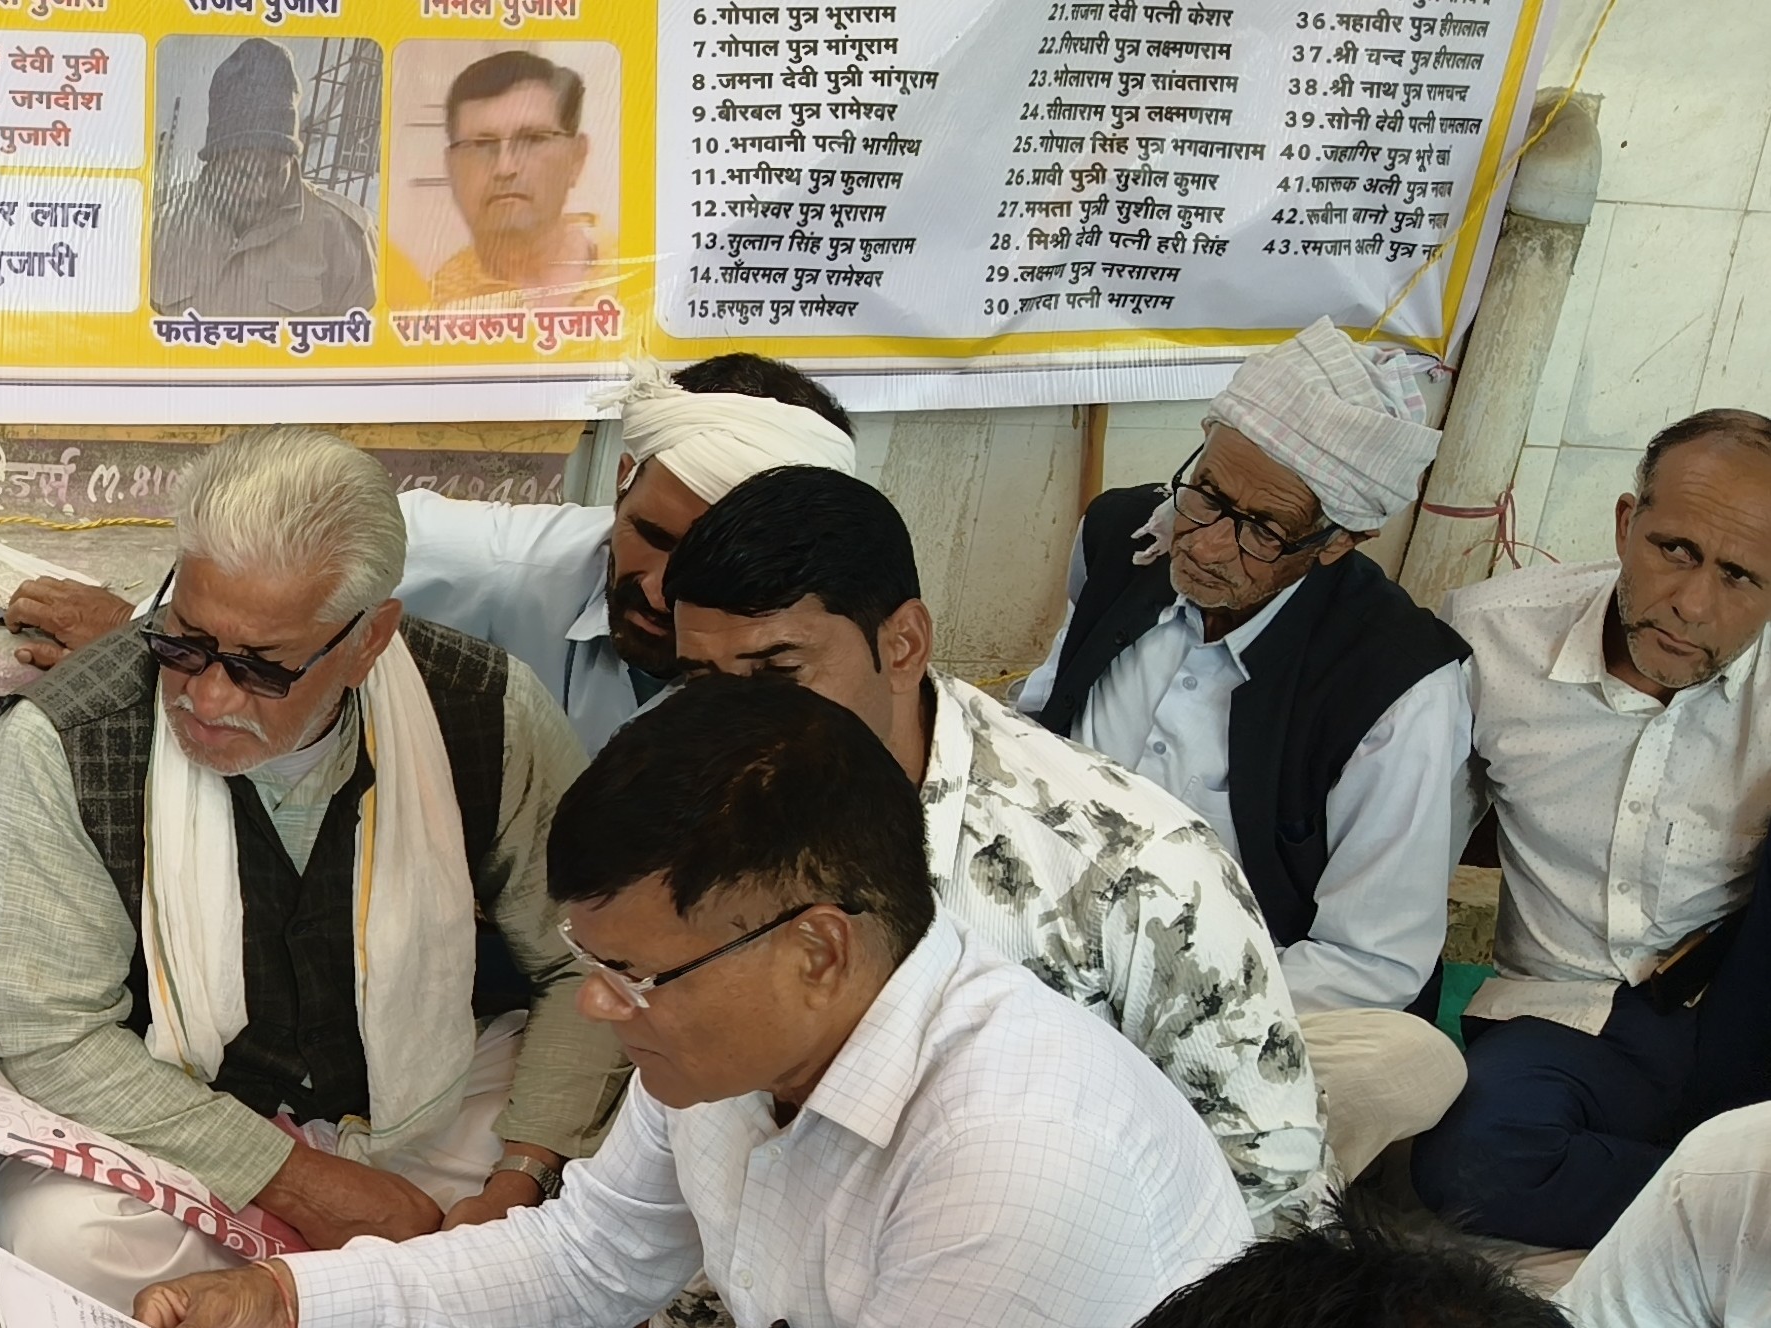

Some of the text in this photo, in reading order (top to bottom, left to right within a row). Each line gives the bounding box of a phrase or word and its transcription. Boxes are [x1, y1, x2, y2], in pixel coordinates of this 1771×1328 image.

[787, 7, 818, 31] पुत्र
[825, 6, 896, 30] भूराराम
[1143, 0, 1182, 25] पत्नी
[1410, 16, 1437, 41] पुत्र
[787, 40, 818, 63] पुत्र
[824, 34, 899, 61] मांगूराम
[1114, 38, 1141, 63] पुत्र
[1409, 49, 1432, 74] पुत्र
[8, 46, 54, 74] देवी
[63, 48, 109, 82] पुत्री
[780, 65, 818, 88] देवी
[825, 64, 863, 94] पुत्री
[870, 66, 939, 95] मांगूराम
[1117, 72, 1145, 96] पुत्र
[9, 84, 103, 111] जगदीश
[1360, 81, 1399, 99] नाथ
[1402, 83, 1423, 107] पुत्र
[789, 103, 822, 126] पुत्र
[827, 96, 898, 122] रामेश्वर
[1111, 105, 1140, 129] पुत्र
[1375, 108, 1403, 133] देवी
[812, 129, 856, 154] पत्नी
[862, 132, 922, 156] भागीरथ
[1091, 131, 1129, 154] सिंह
[1136, 137, 1166, 160] पुत्र
[1383, 147, 1413, 171] पुत्र
[808, 169, 836, 194] पुत्र
[840, 169, 903, 195] फुलाराम
[1070, 162, 1107, 192] पुत्री
[1115, 163, 1169, 192] सुशील
[1174, 172, 1219, 197] कुमार
[1362, 176, 1402, 196] अली
[1403, 181, 1429, 204] पुत्र
[27, 202, 101, 229] लाल
[797, 203, 825, 227] पुत्र
[830, 204, 887, 227] भूराराम
[1079, 194, 1109, 223] पुत्री
[1116, 197, 1173, 224] सुशील
[1177, 205, 1225, 229] कुमार
[1390, 207, 1425, 233] पुत्री
[788, 229, 823, 253] सिंह
[826, 237, 855, 260] पुत्र
[860, 238, 916, 262] फुलाराम
[1109, 227, 1152, 250] पत्नी
[1193, 232, 1229, 257] सिंह
[1354, 233, 1384, 256] अली
[1386, 240, 1417, 262] पुत्र
[791, 267, 822, 291] पुत्र
[826, 265, 883, 287] रामेश्वर
[1068, 261, 1097, 284] पुत्र
[769, 300, 794, 324] पुत्र
[799, 295, 859, 318] रामेश्वर
[1066, 286, 1101, 310] पत्नी
[153, 311, 372, 352] फतेहचन्द पुजारी
[533, 301, 621, 350] पुजारी
